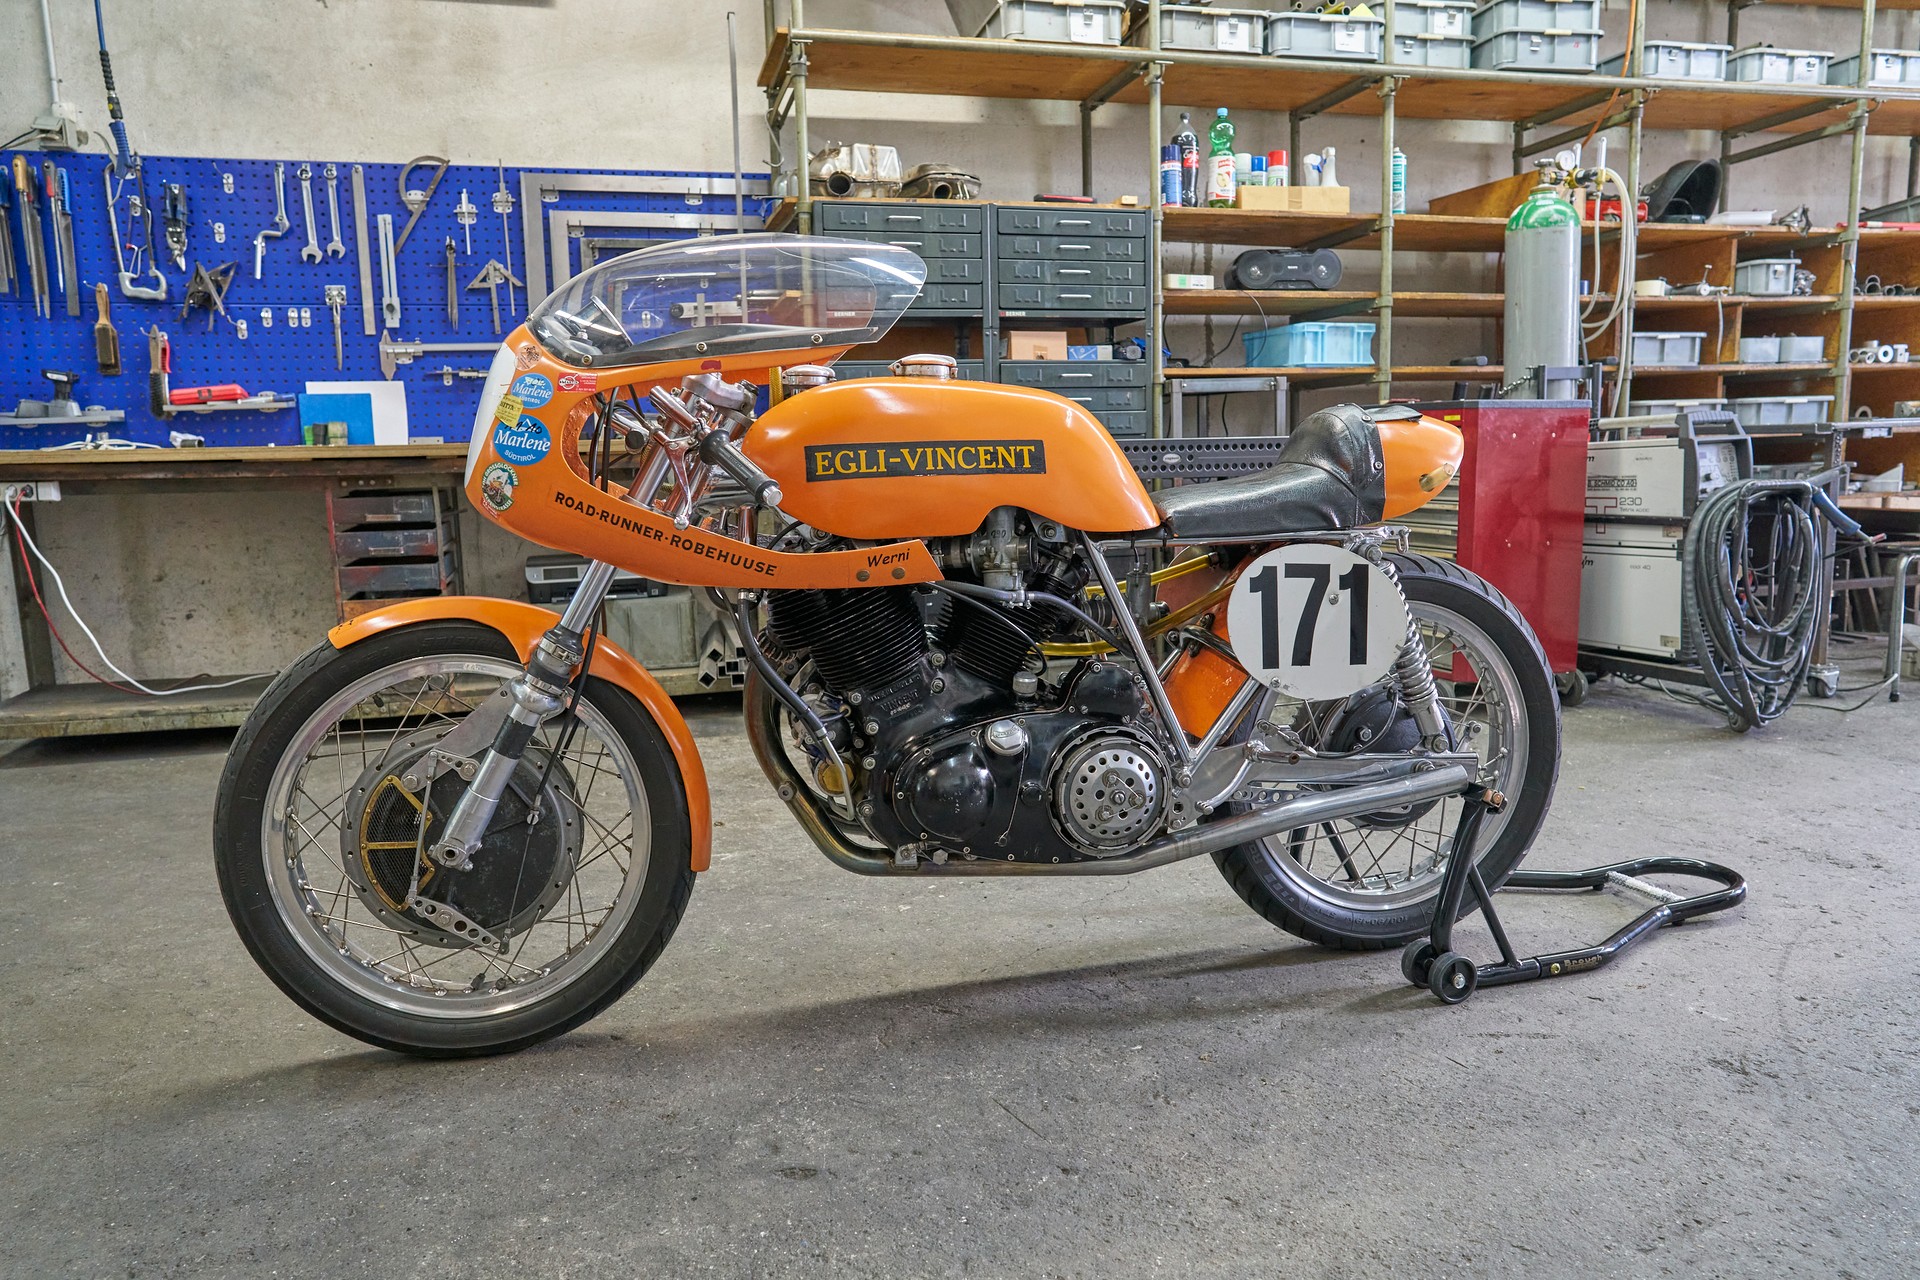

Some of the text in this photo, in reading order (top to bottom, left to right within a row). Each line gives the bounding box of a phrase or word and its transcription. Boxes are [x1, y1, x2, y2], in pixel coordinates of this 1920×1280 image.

[513, 382, 552, 399] Marlene
[494, 430, 551, 452] Marlene
[504, 449, 536, 462] SÜDTIROL
[815, 445, 1035, 476] EGLI-VINCENT
[1619, 497, 1642, 506] 230
[867, 548, 910, 568] Werni
[1249, 563, 1369, 669] 171
